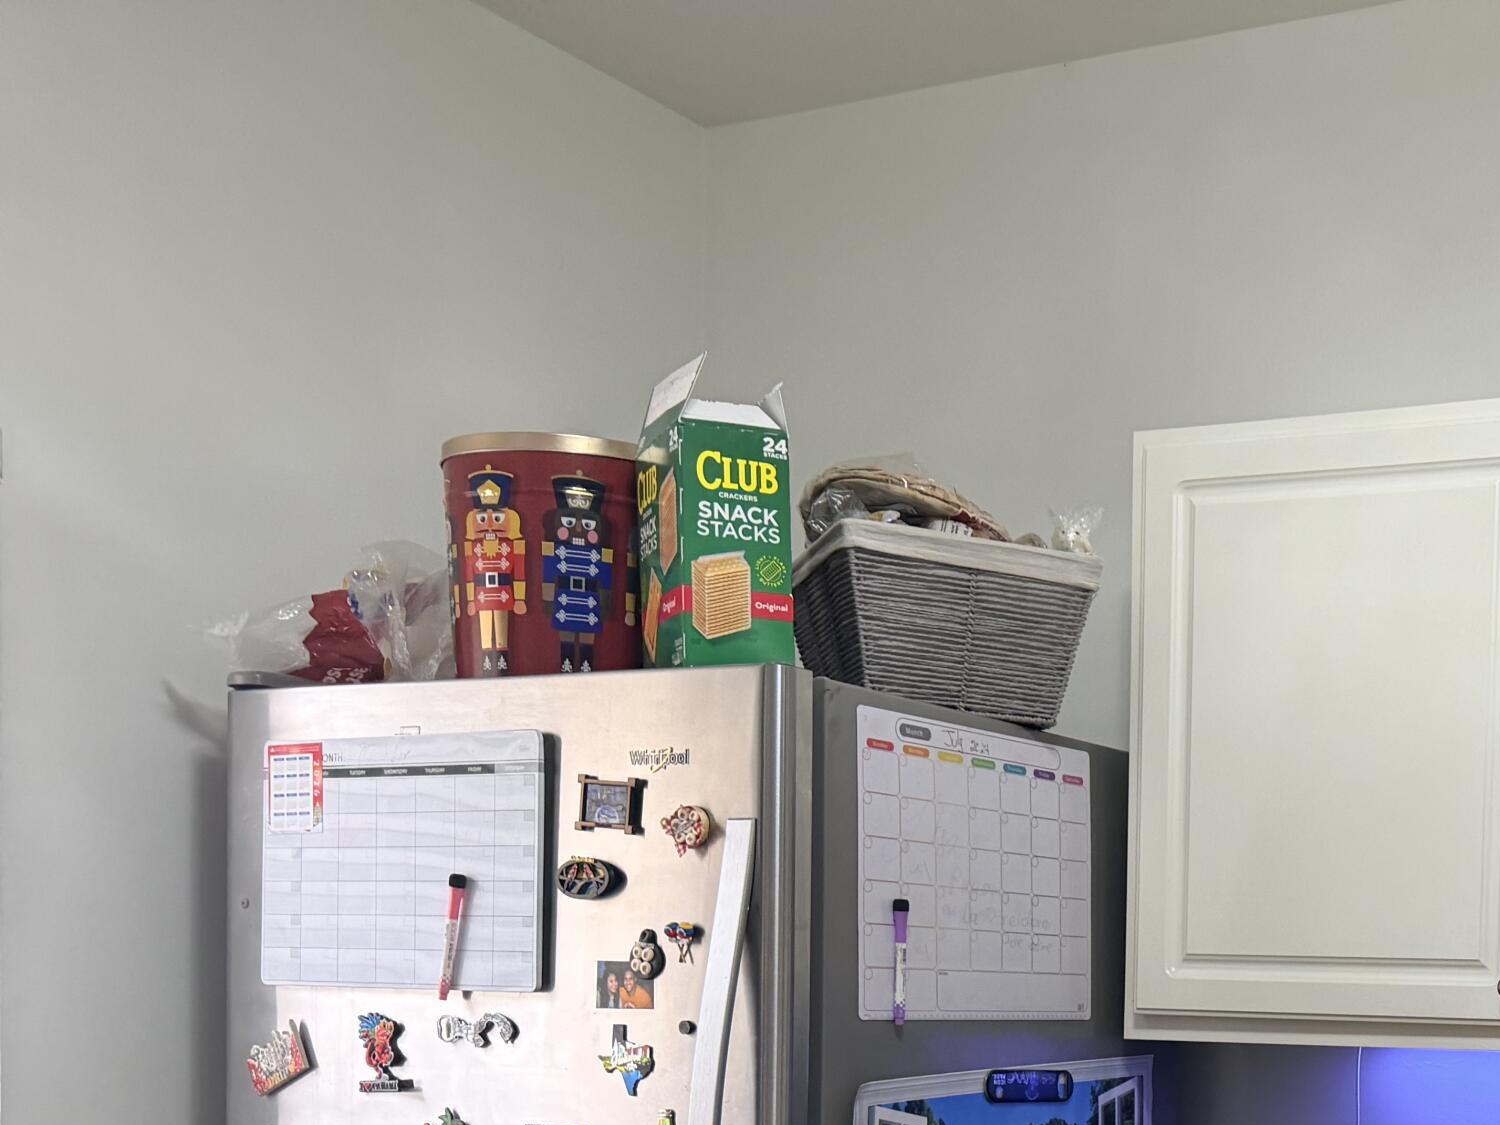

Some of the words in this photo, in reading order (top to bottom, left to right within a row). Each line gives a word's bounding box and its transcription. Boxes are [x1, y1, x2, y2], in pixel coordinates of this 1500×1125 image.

[762, 436, 788, 454] 24
[763, 451, 787, 460] STACKS
[696, 450, 779, 495] CLUB
[637, 464, 658, 515] CLUB
[718, 491, 758, 503] CRACKERS
[698, 500, 779, 527] SNACK
[640, 514, 657, 544] SNACK
[697, 520, 781, 545] STACKS
[754, 601, 789, 613] Original
[629, 747, 690, 773] Whirlpool
